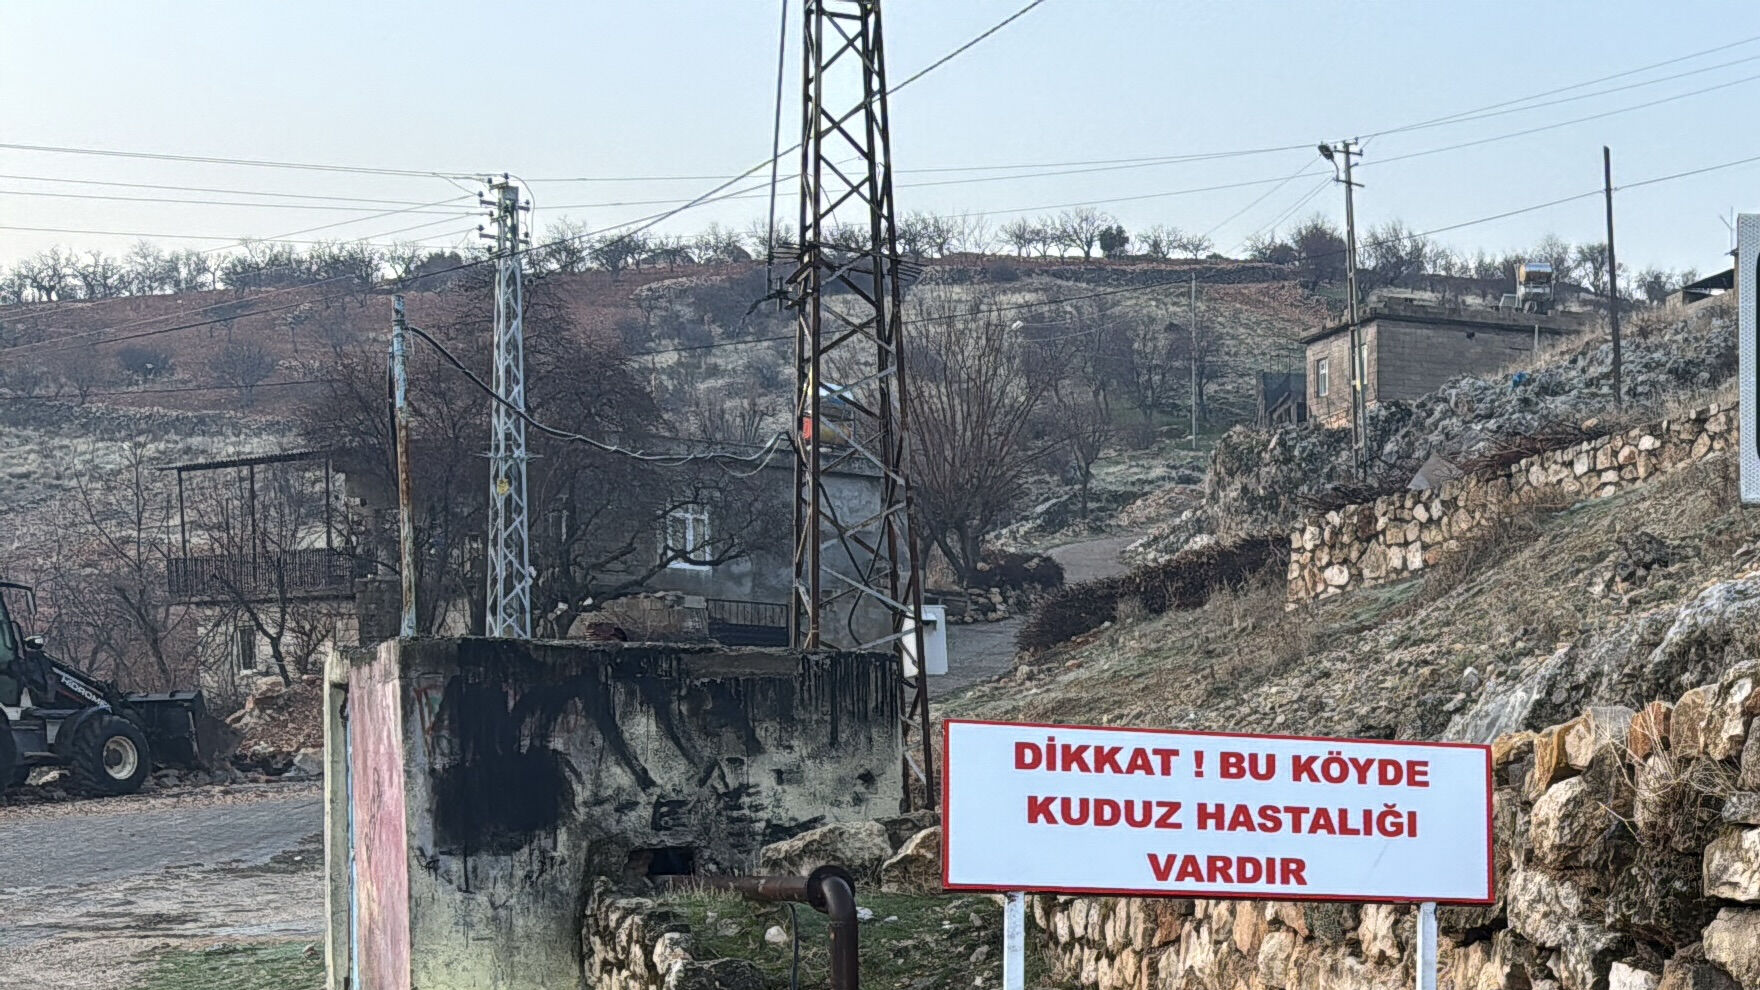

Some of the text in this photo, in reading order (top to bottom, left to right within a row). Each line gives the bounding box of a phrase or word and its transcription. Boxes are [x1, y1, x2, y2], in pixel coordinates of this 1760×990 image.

[1014, 736, 1430, 788] DİKKAT ! BU KÖYDE
[1027, 796, 1418, 839] KUDUZ HASTALIĞI
[1148, 853, 1307, 886] VARDIR
